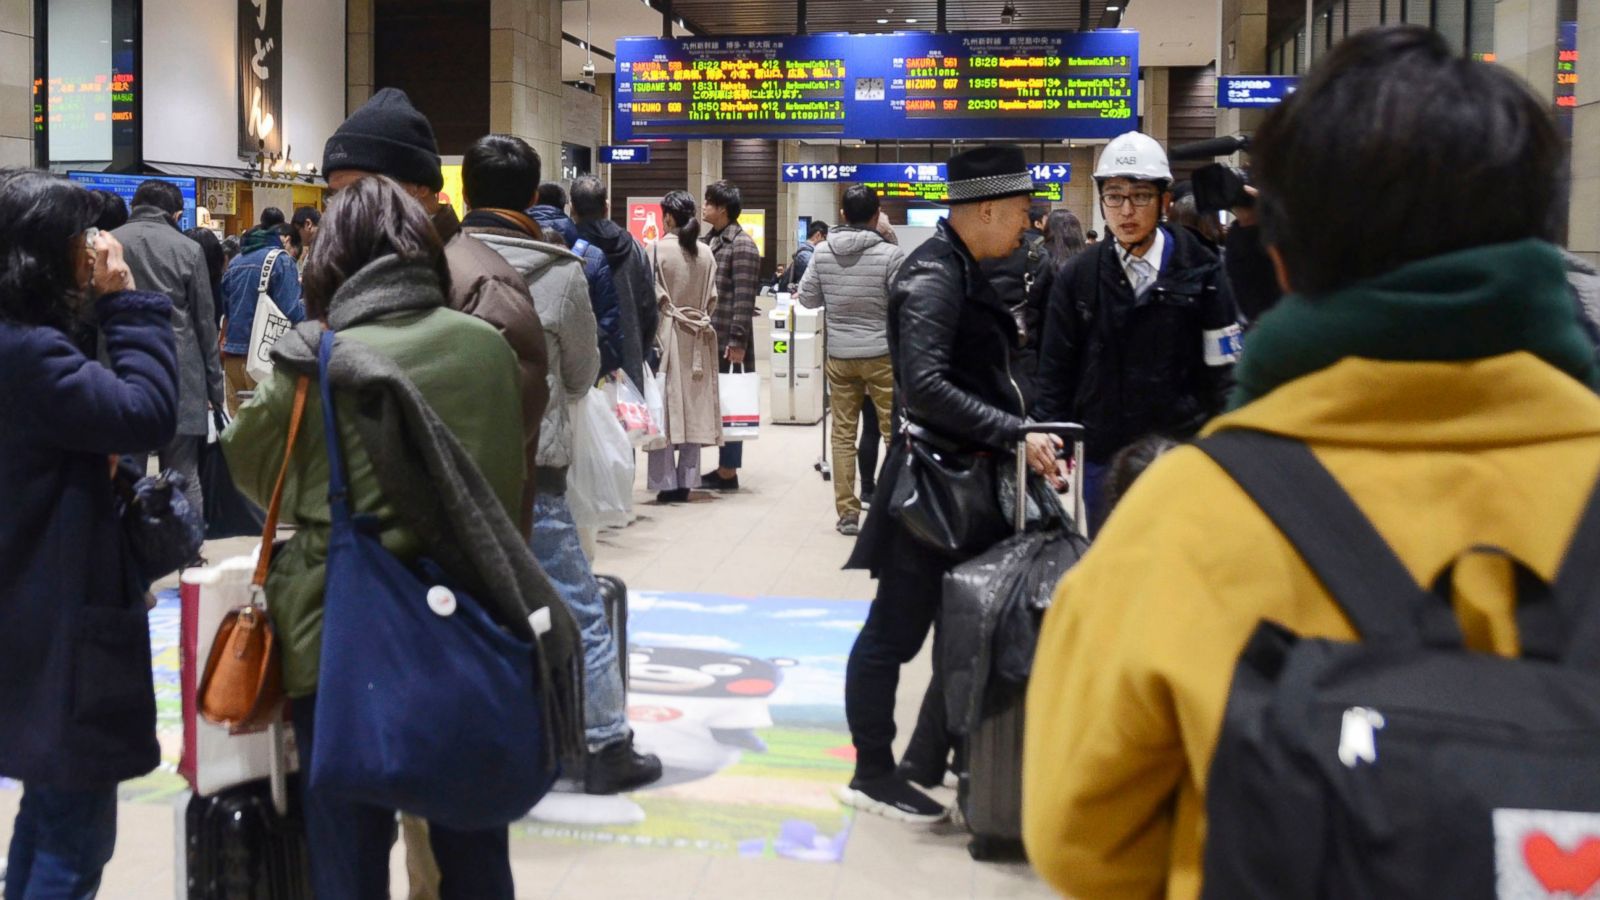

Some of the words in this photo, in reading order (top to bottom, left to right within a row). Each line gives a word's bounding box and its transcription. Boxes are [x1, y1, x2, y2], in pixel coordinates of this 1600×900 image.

[682, 41, 719, 50] 九州新幹線
[962, 37, 1002, 46] 九州新幹線
[1009, 37, 1048, 45] 鹿児島中央
[632, 62, 661, 71] SAKURA
[692, 61, 719, 70] 18:22
[905, 58, 937, 68] SAKURA
[910, 68, 960, 77] stations.
[633, 82, 665, 92] TSUBAME
[692, 82, 718, 90] 18:31
[906, 79, 937, 89] MIZUHO
[969, 79, 998, 88] 19:55
[1017, 88, 1040, 97] This
[1046, 87, 1075, 97] train
[1080, 87, 1103, 97] will
[1109, 87, 1121, 97] be
[632, 102, 661, 112] MIZUHO
[692, 102, 719, 111] 18:50
[905, 100, 936, 111] SAKURA
[967, 100, 998, 110] 20:30
[688, 111, 710, 120] This
[716, 111, 742, 120] train
[747, 111, 769, 120] will
[774, 110, 786, 119] be
[791, 110, 836, 121] stopping
[1114, 156, 1137, 165] KAB
